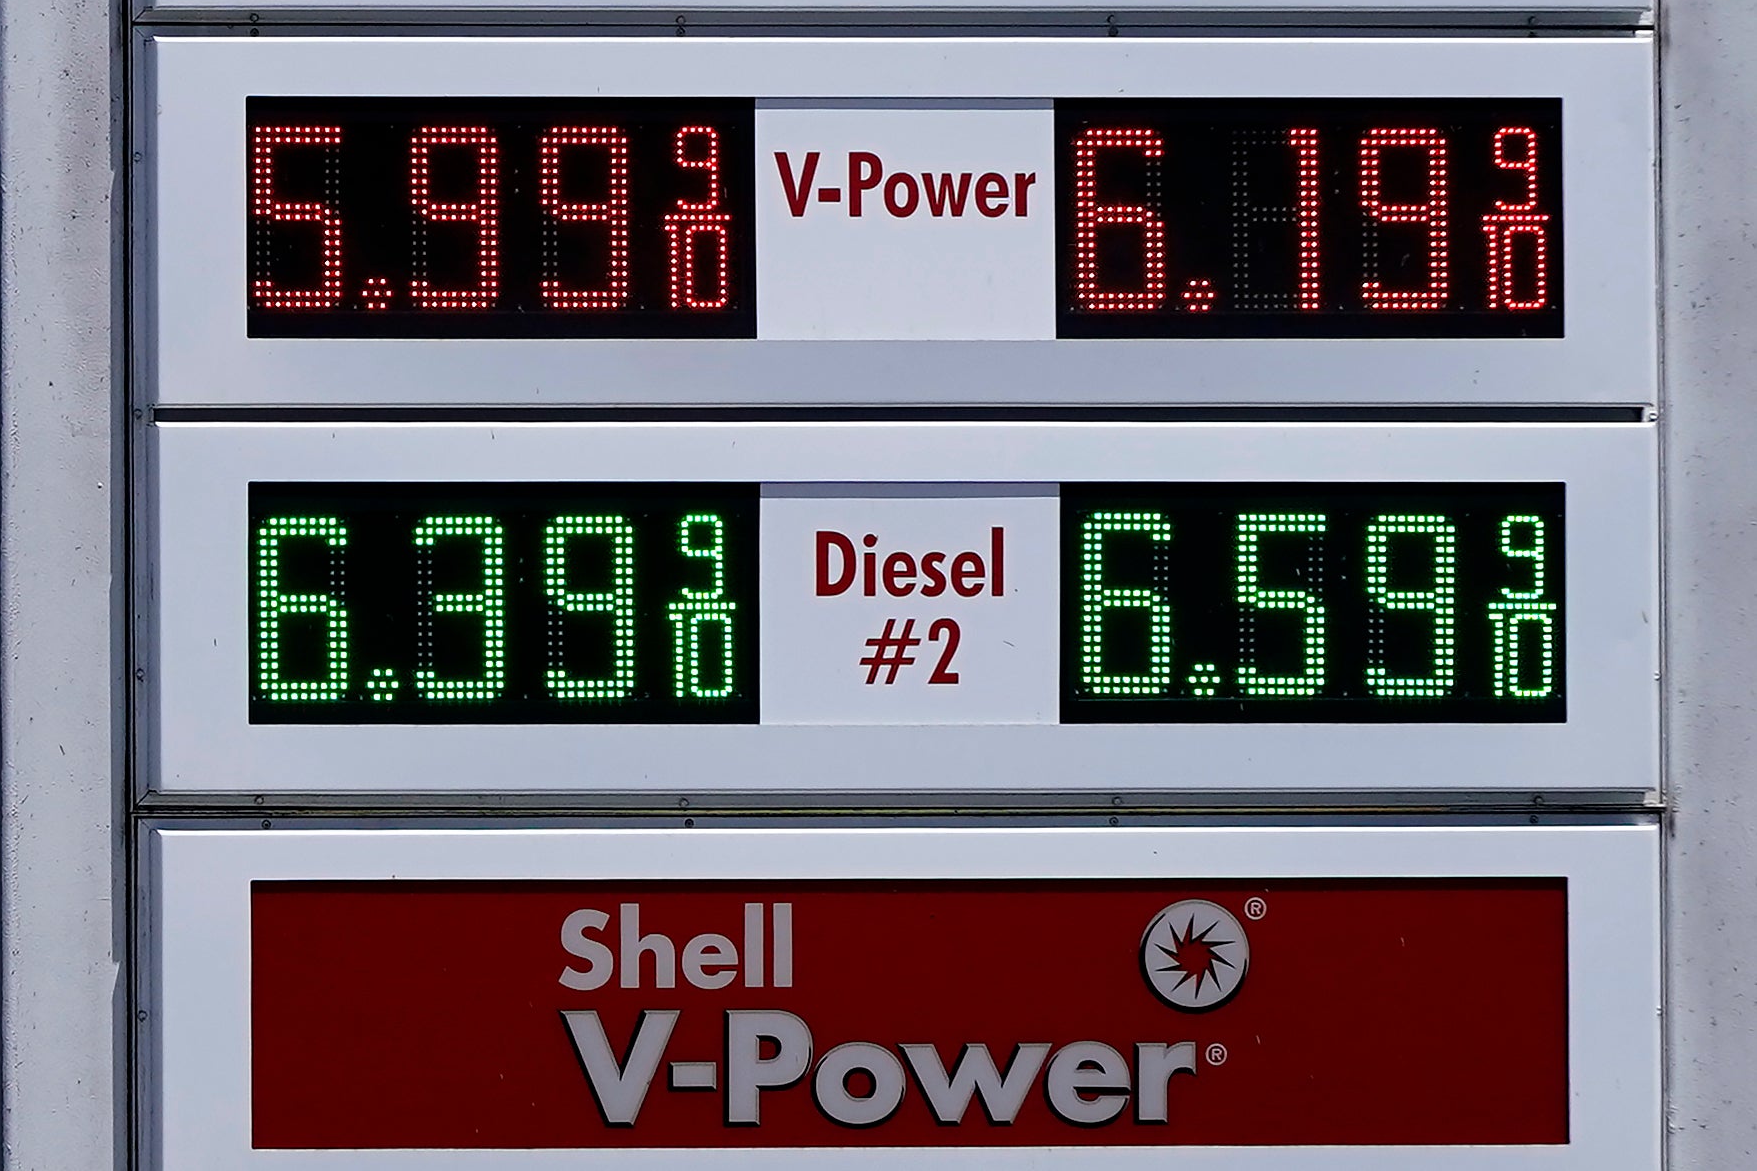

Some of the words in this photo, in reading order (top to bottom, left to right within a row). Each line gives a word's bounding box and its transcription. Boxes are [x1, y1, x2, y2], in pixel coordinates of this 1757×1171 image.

[255, 126, 627, 309] 5.99
[774, 154, 1036, 218] V-Power
[1077, 128, 1448, 312] 6.19
[259, 516, 634, 700] 6.39
[814, 530, 1005, 597] Diesel
[1083, 513, 1455, 696] 6.59
[859, 621, 961, 684] #2
[559, 903, 792, 990] Shell
